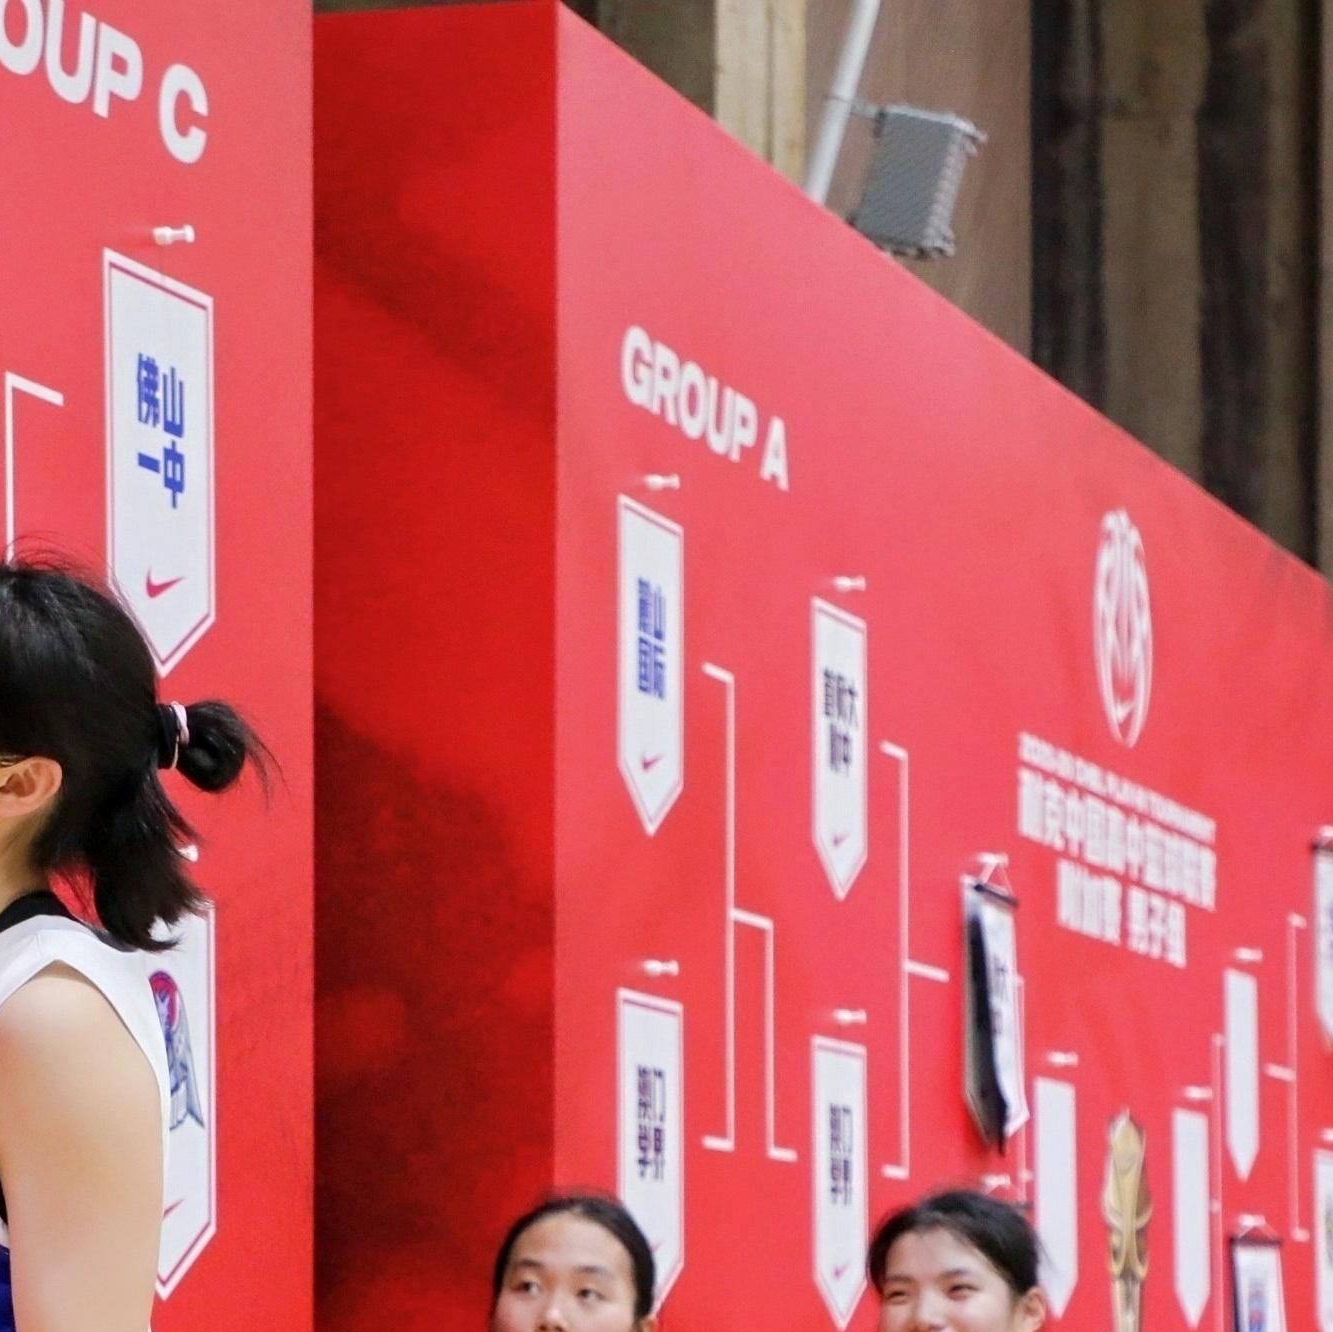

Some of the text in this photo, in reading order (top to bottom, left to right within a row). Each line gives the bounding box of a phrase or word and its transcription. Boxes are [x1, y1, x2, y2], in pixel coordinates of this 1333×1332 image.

[158, 63, 209, 163] C
[620, 325, 790, 492] GROUP A
